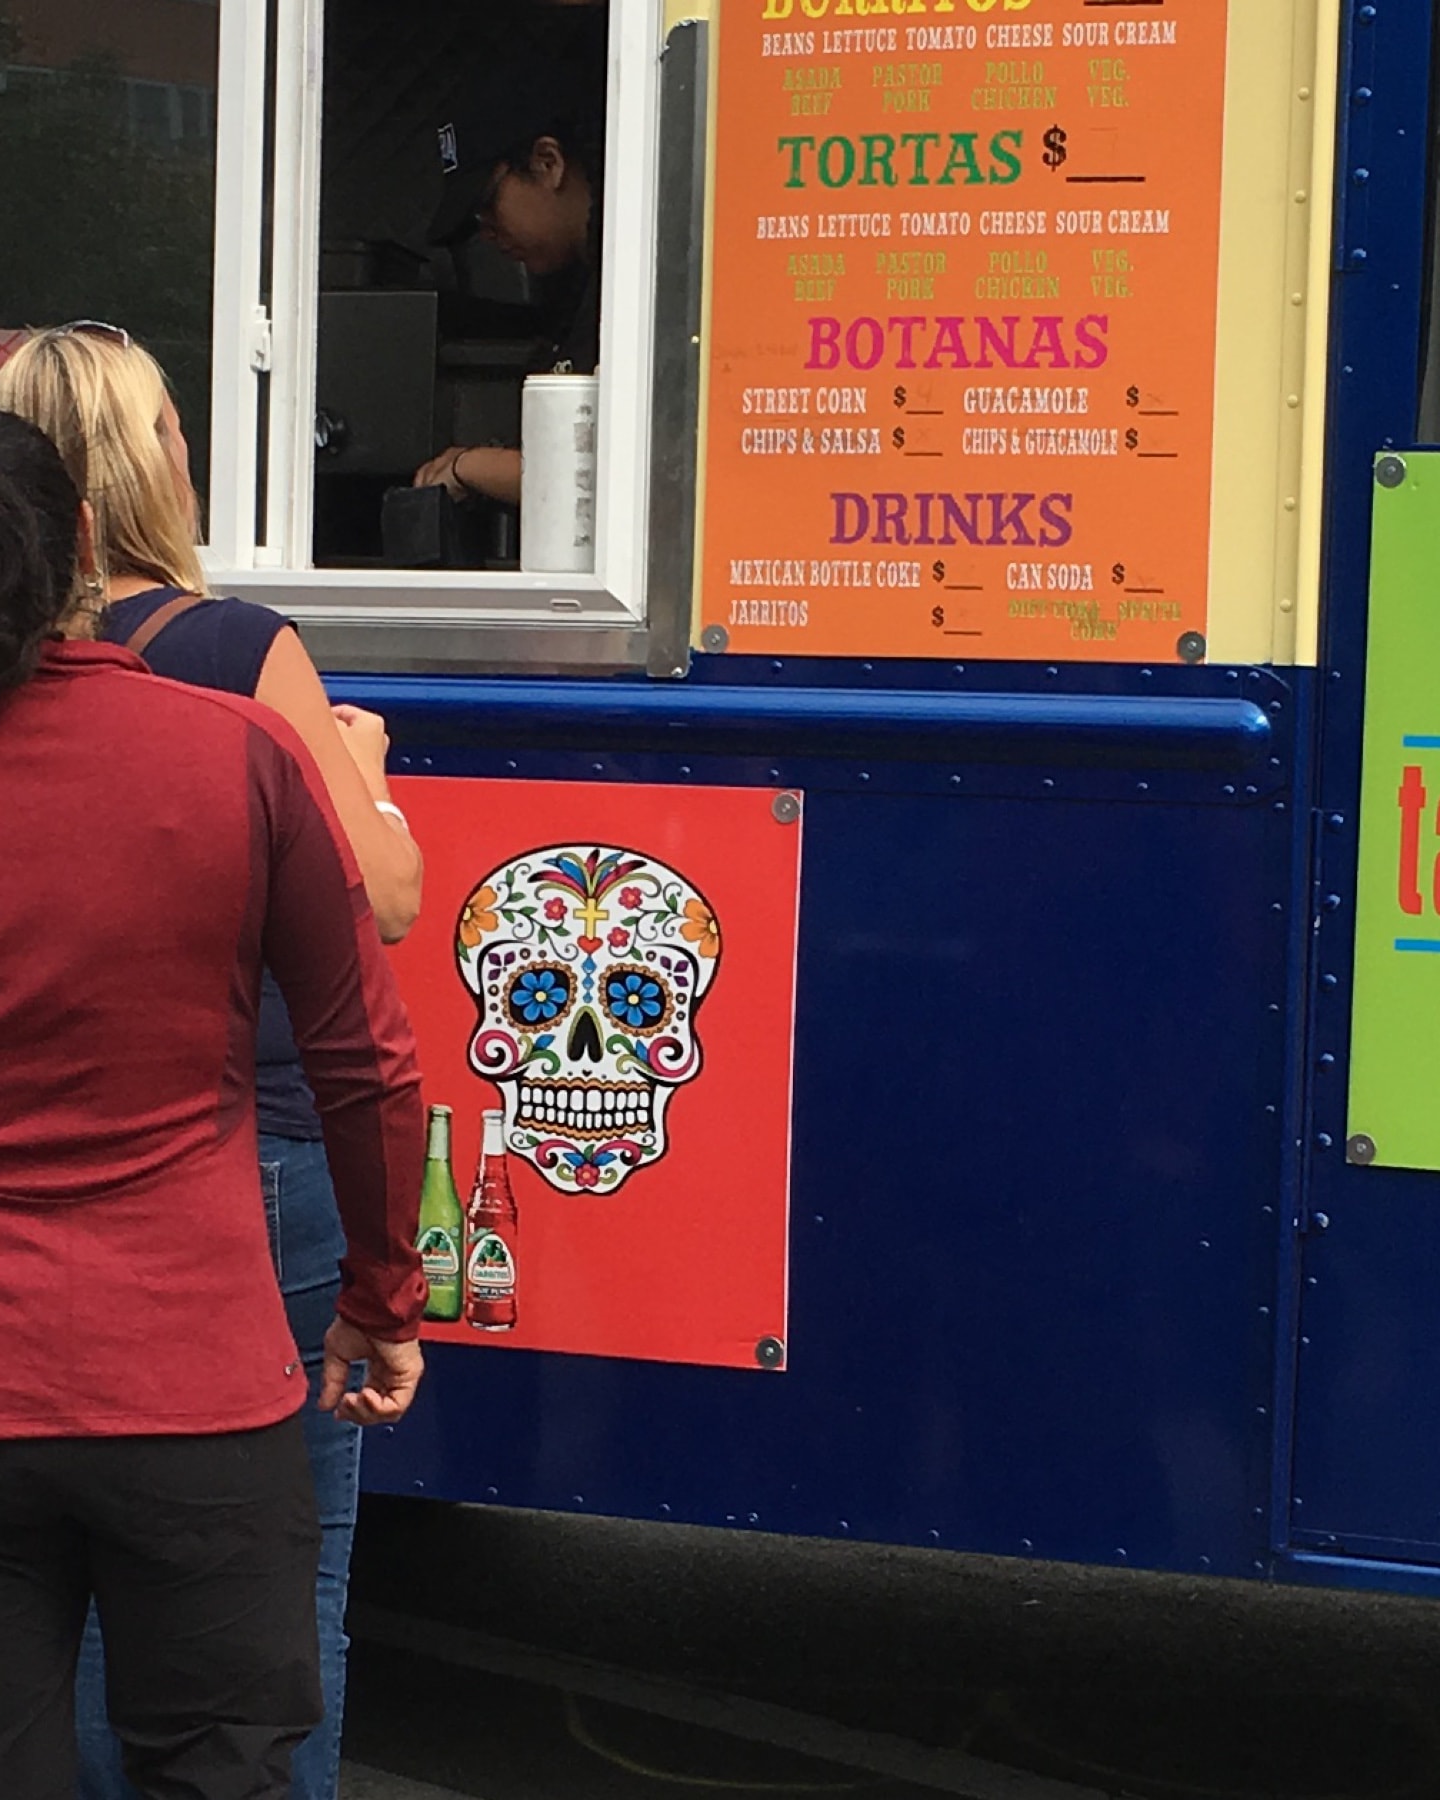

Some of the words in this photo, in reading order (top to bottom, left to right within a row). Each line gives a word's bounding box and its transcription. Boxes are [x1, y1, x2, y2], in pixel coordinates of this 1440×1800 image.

[763, 32, 814, 56] BEANS
[823, 28, 896, 53] LETTUCE
[906, 26, 976, 50] TOMATO
[987, 24, 1053, 48] CHEESE
[1063, 23, 1109, 46] SOUR
[1114, 21, 1176, 45] CREAM
[985, 61, 1044, 85] POLLO
[779, 131, 1022, 188] TORTAS
[757, 216, 809, 239] BEANS
[818, 213, 891, 237] LETTUCE
[900, 212, 970, 235] TOMATO
[980, 211, 1046, 234] CHEESE
[1056, 211, 1102, 233] SOUR
[1108, 210, 1169, 233] CREAM
[988, 249, 1048, 274] POLLO
[805, 315, 1108, 370] BOTANAS
[743, 388, 811, 413] STREET
[817, 387, 866, 413] CORN
[964, 387, 1088, 413] GUACAMOLE
[742, 428, 798, 454] CHIPS
[800, 428, 815, 454] &
[820, 428, 880, 454] SALSA
[963, 428, 1006, 454] CHIPS
[1011, 429, 1020, 454] &
[1025, 428, 1117, 455] GUACAMOLE
[830, 493, 1072, 546] DRINKS
[730, 560, 805, 586] MEXICAN
[810, 560, 872, 586] BOTTLE
[876, 561, 920, 587] COKE
[1007, 563, 1042, 589] CAN
[1047, 564, 1093, 590] SODA
[729, 600, 808, 626] JARRITOS
